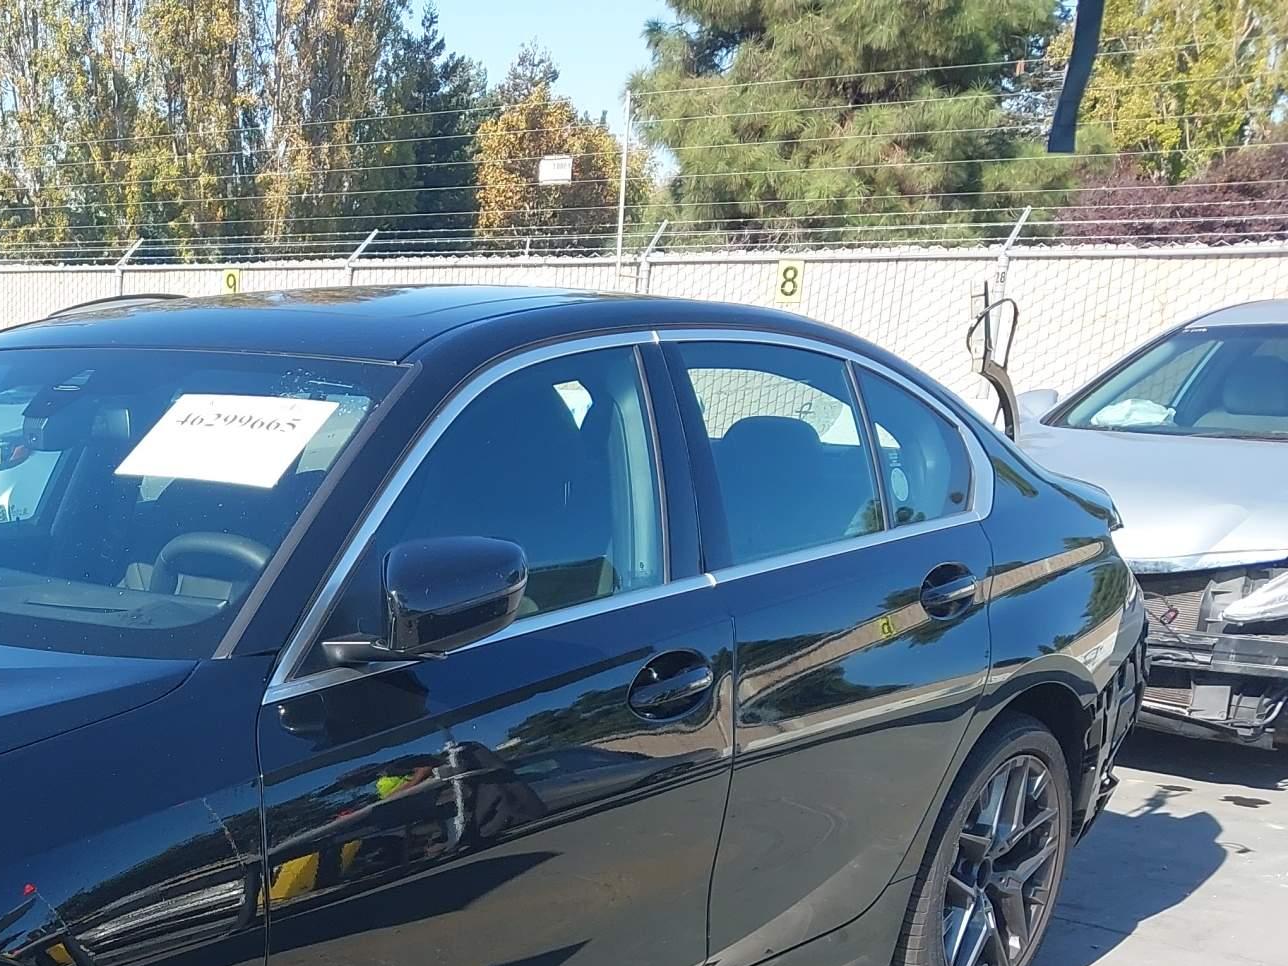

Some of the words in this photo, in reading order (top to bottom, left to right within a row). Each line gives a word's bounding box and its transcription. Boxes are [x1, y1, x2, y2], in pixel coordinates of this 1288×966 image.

[226, 273, 237, 294] 9
[780, 265, 799, 297] 8
[176, 412, 302, 433] 46299665
